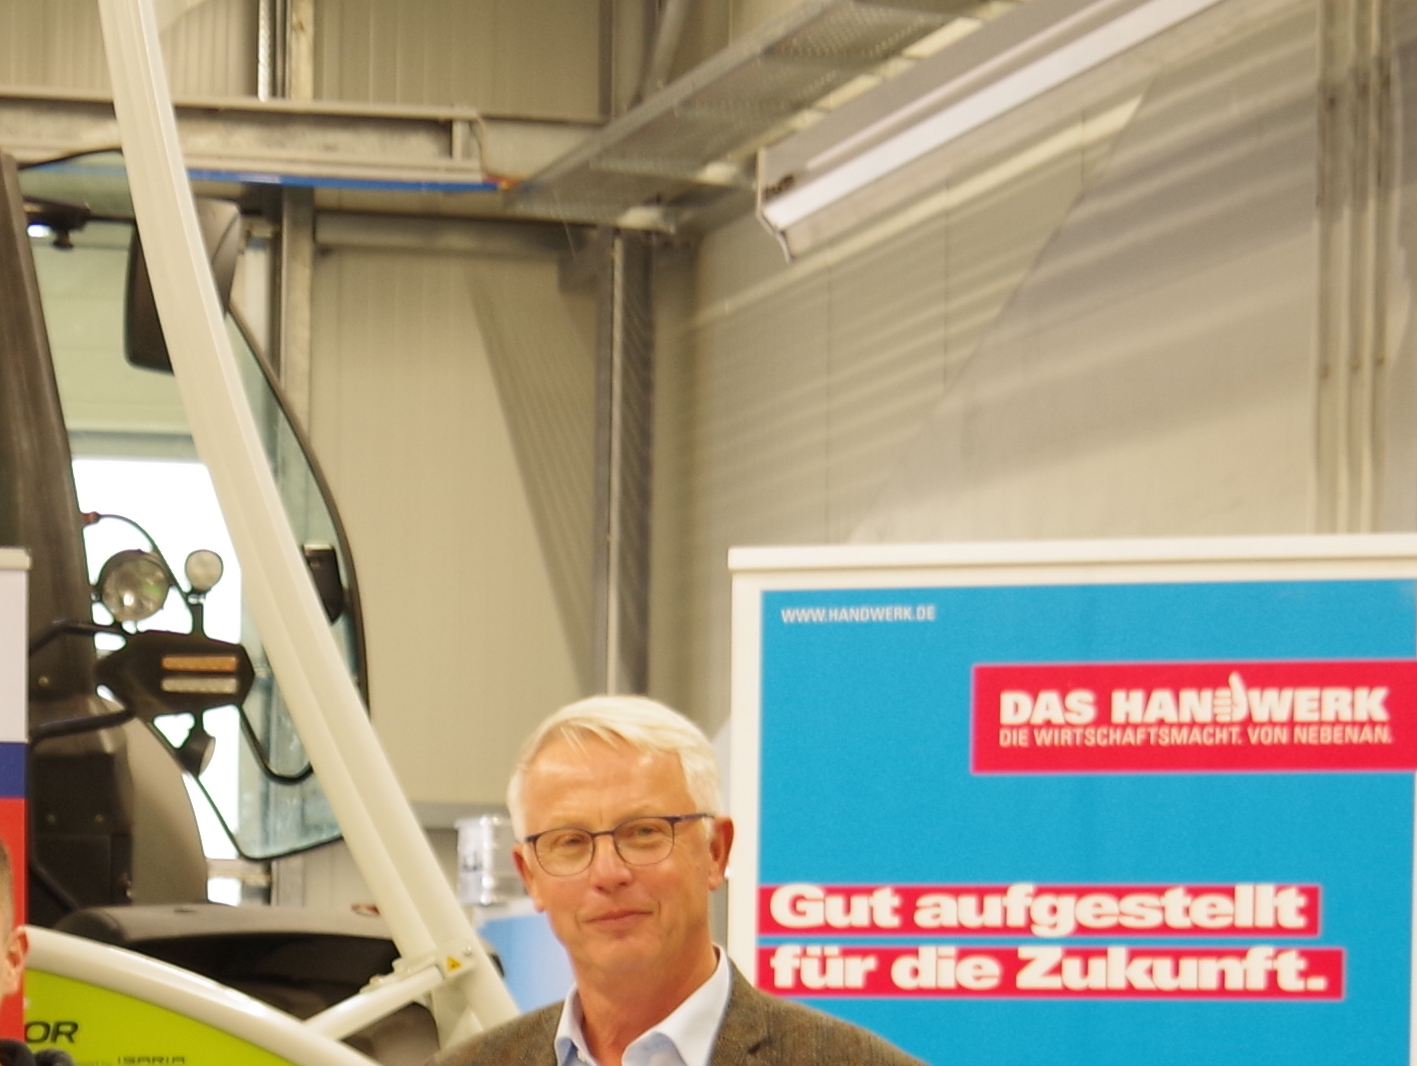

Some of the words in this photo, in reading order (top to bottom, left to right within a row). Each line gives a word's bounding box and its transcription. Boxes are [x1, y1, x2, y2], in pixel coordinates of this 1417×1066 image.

[781, 606, 936, 623] WWW.HANDWERK.DE
[999, 690, 1096, 725] DAS
[998, 727, 1029, 747] DIE
[1034, 725, 1243, 746] WIRTSCHAFTSMACHT.
[1247, 726, 1288, 744] VON
[1293, 724, 1392, 744] NEBENAN.
[770, 884, 903, 928] Gut
[914, 883, 1307, 938] aufgestellt
[770, 944, 877, 988] für
[890, 945, 1000, 990] die
[1015, 945, 1328, 991] Zukunft.
